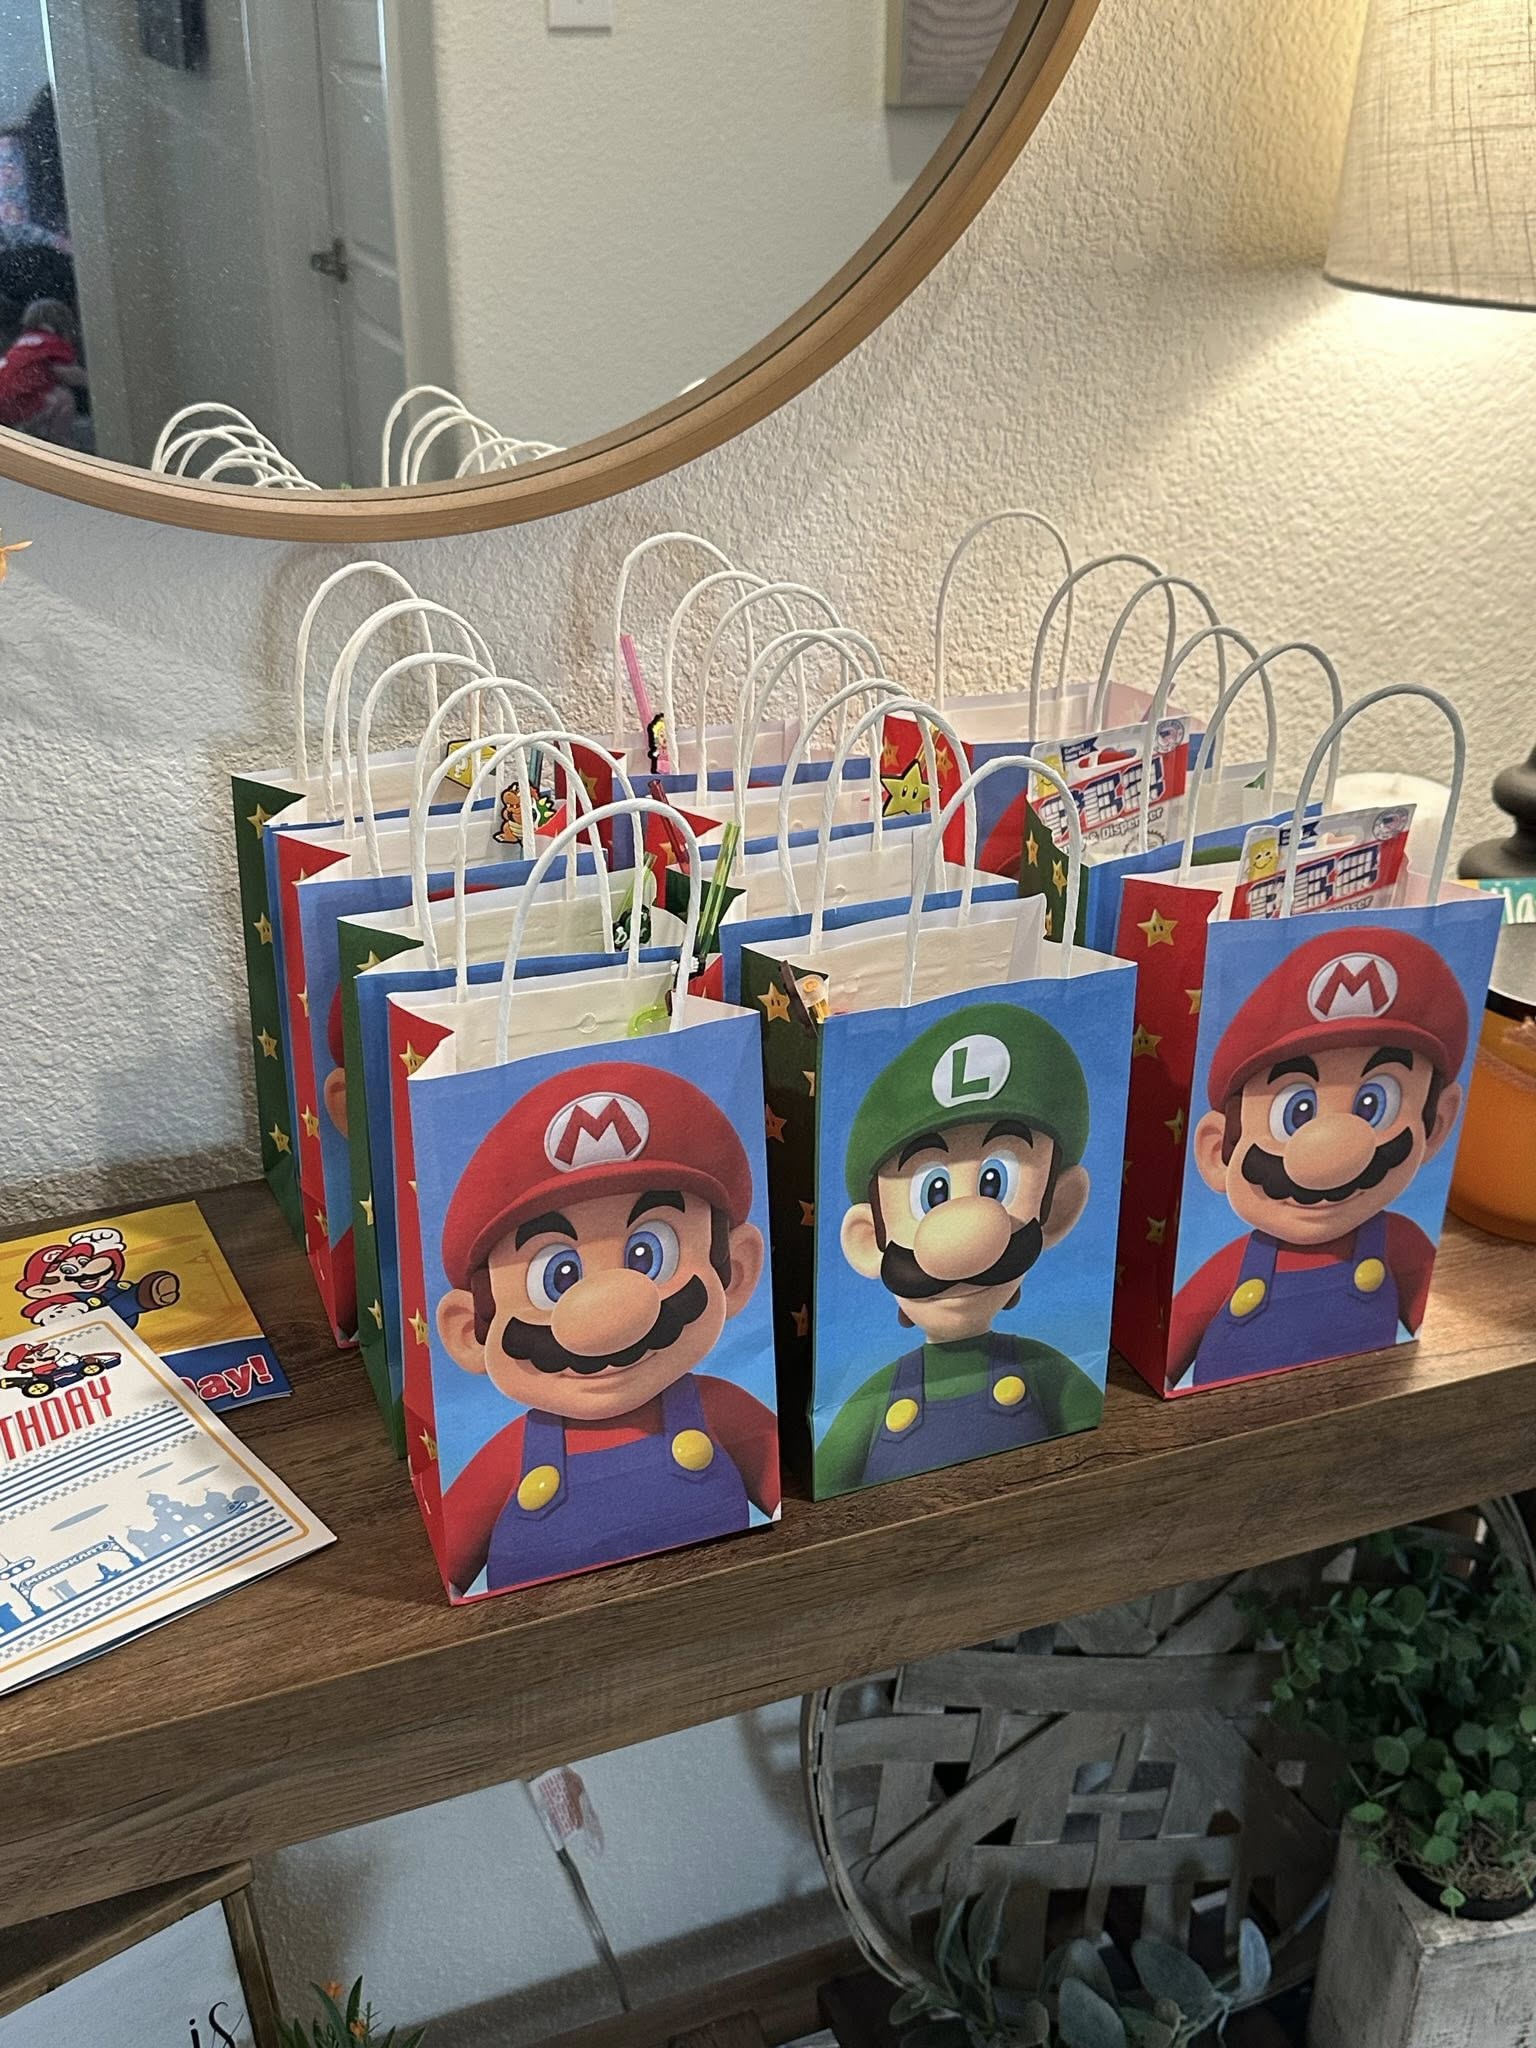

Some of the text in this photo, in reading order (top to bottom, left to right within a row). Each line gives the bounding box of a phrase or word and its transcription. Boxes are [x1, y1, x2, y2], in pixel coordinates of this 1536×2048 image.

[1315, 960, 1389, 1016] M
[951, 1047, 990, 1099] L
[554, 1098, 642, 1166] M
